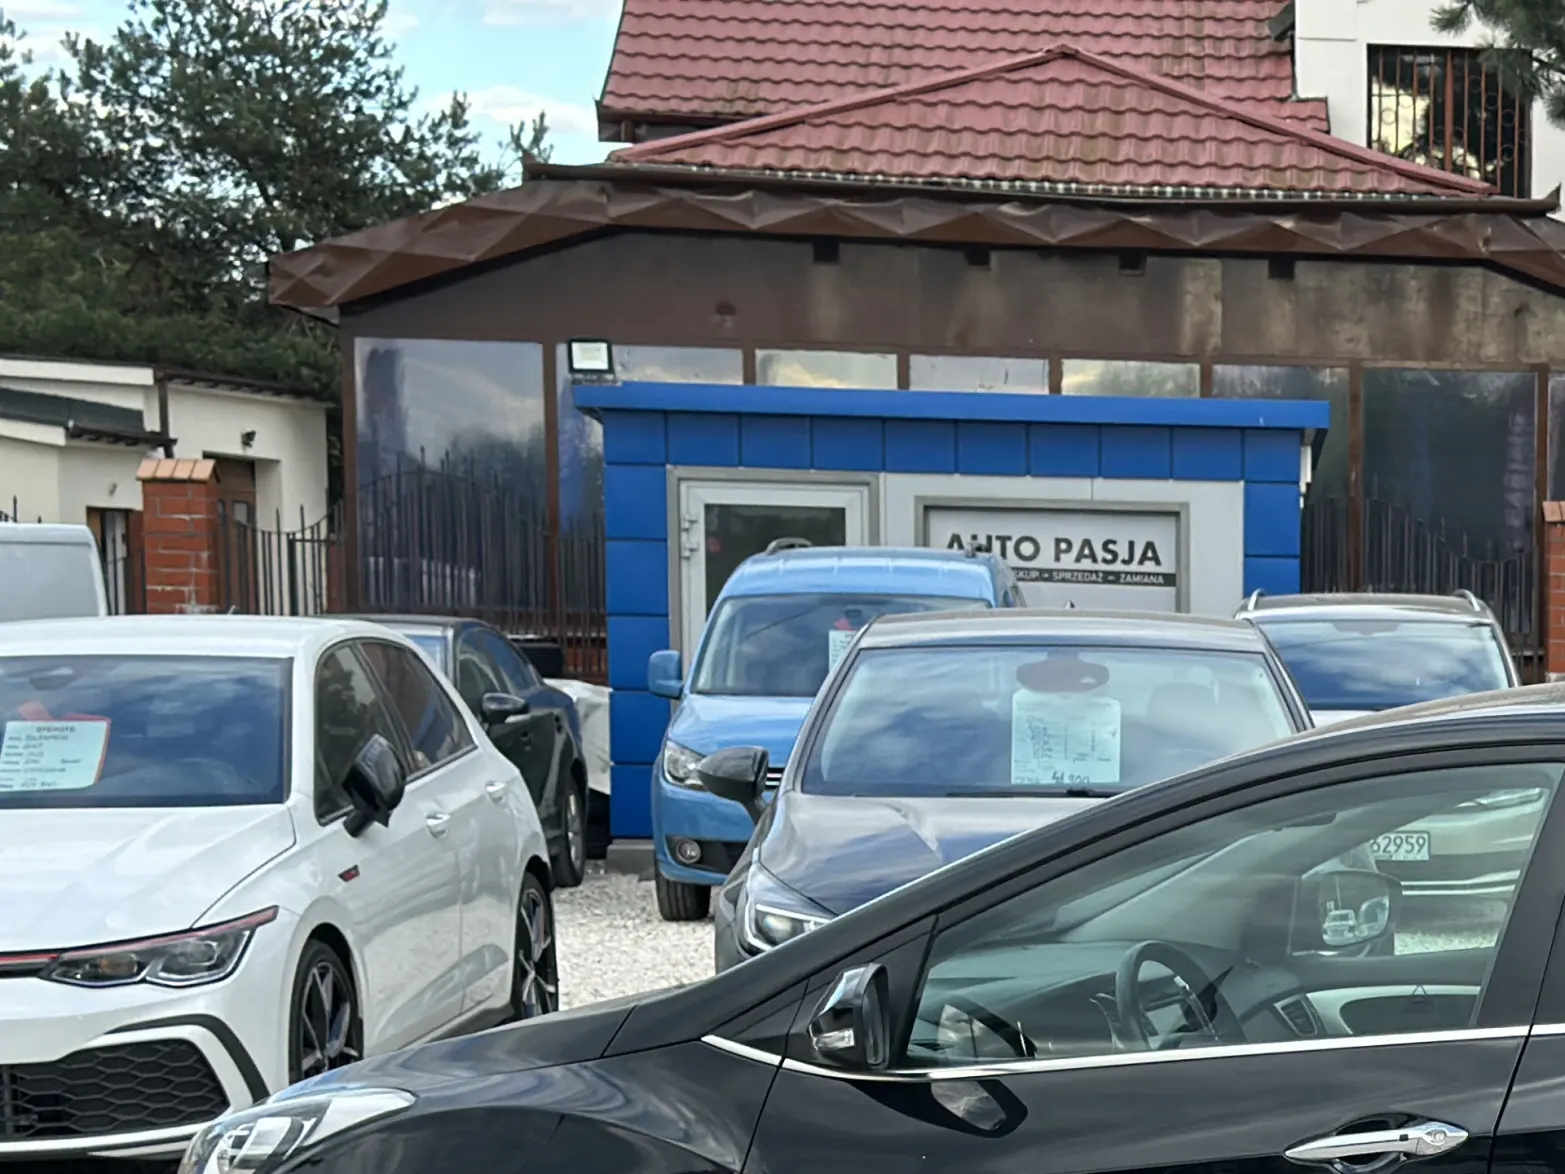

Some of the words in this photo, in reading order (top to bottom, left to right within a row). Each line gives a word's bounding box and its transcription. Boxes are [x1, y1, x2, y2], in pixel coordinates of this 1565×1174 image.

[1053, 537, 1162, 566] PASJA
[1119, 573, 1164, 585] ZAMIANA
[1370, 835, 1427, 855] 62959
